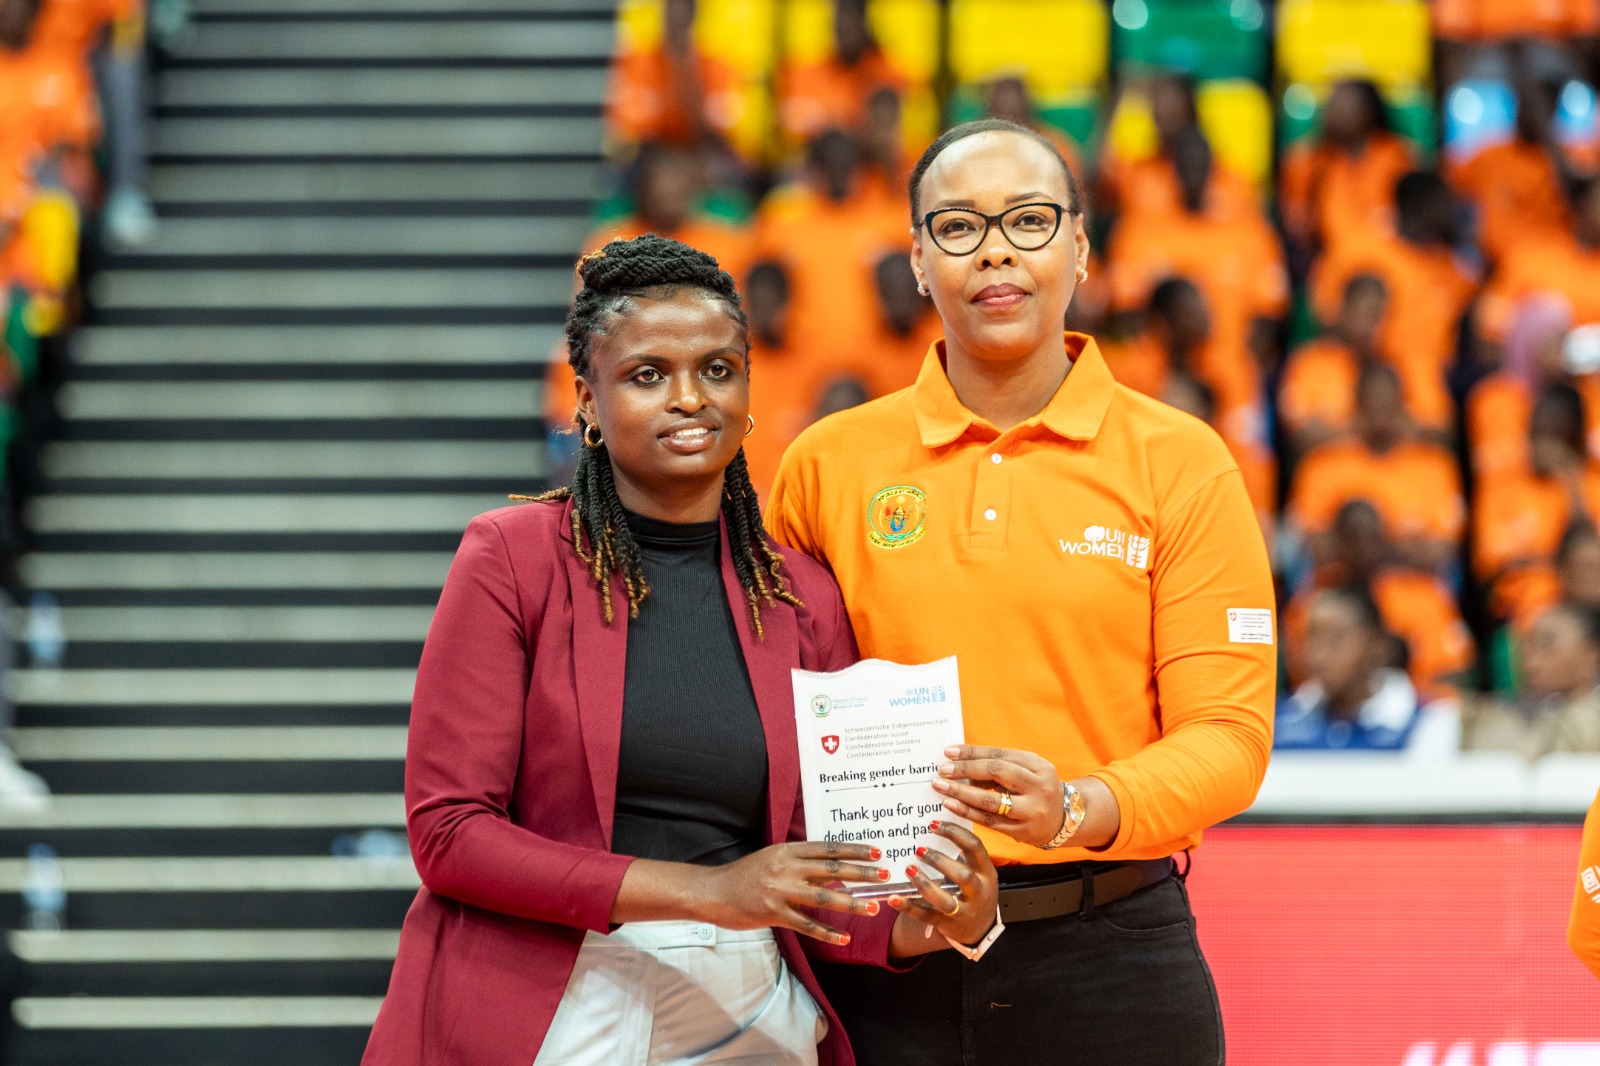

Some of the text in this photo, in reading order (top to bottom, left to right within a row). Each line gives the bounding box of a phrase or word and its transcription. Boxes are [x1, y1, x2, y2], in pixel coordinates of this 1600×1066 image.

[914, 687, 929, 696] UN
[889, 696, 930, 706] WOMEN
[819, 770, 867, 783] Breaking
[869, 766, 906, 781] gender
[830, 802, 943, 822] Thank you for your
[824, 829, 885, 843] dedication
[888, 823, 910, 838] and
